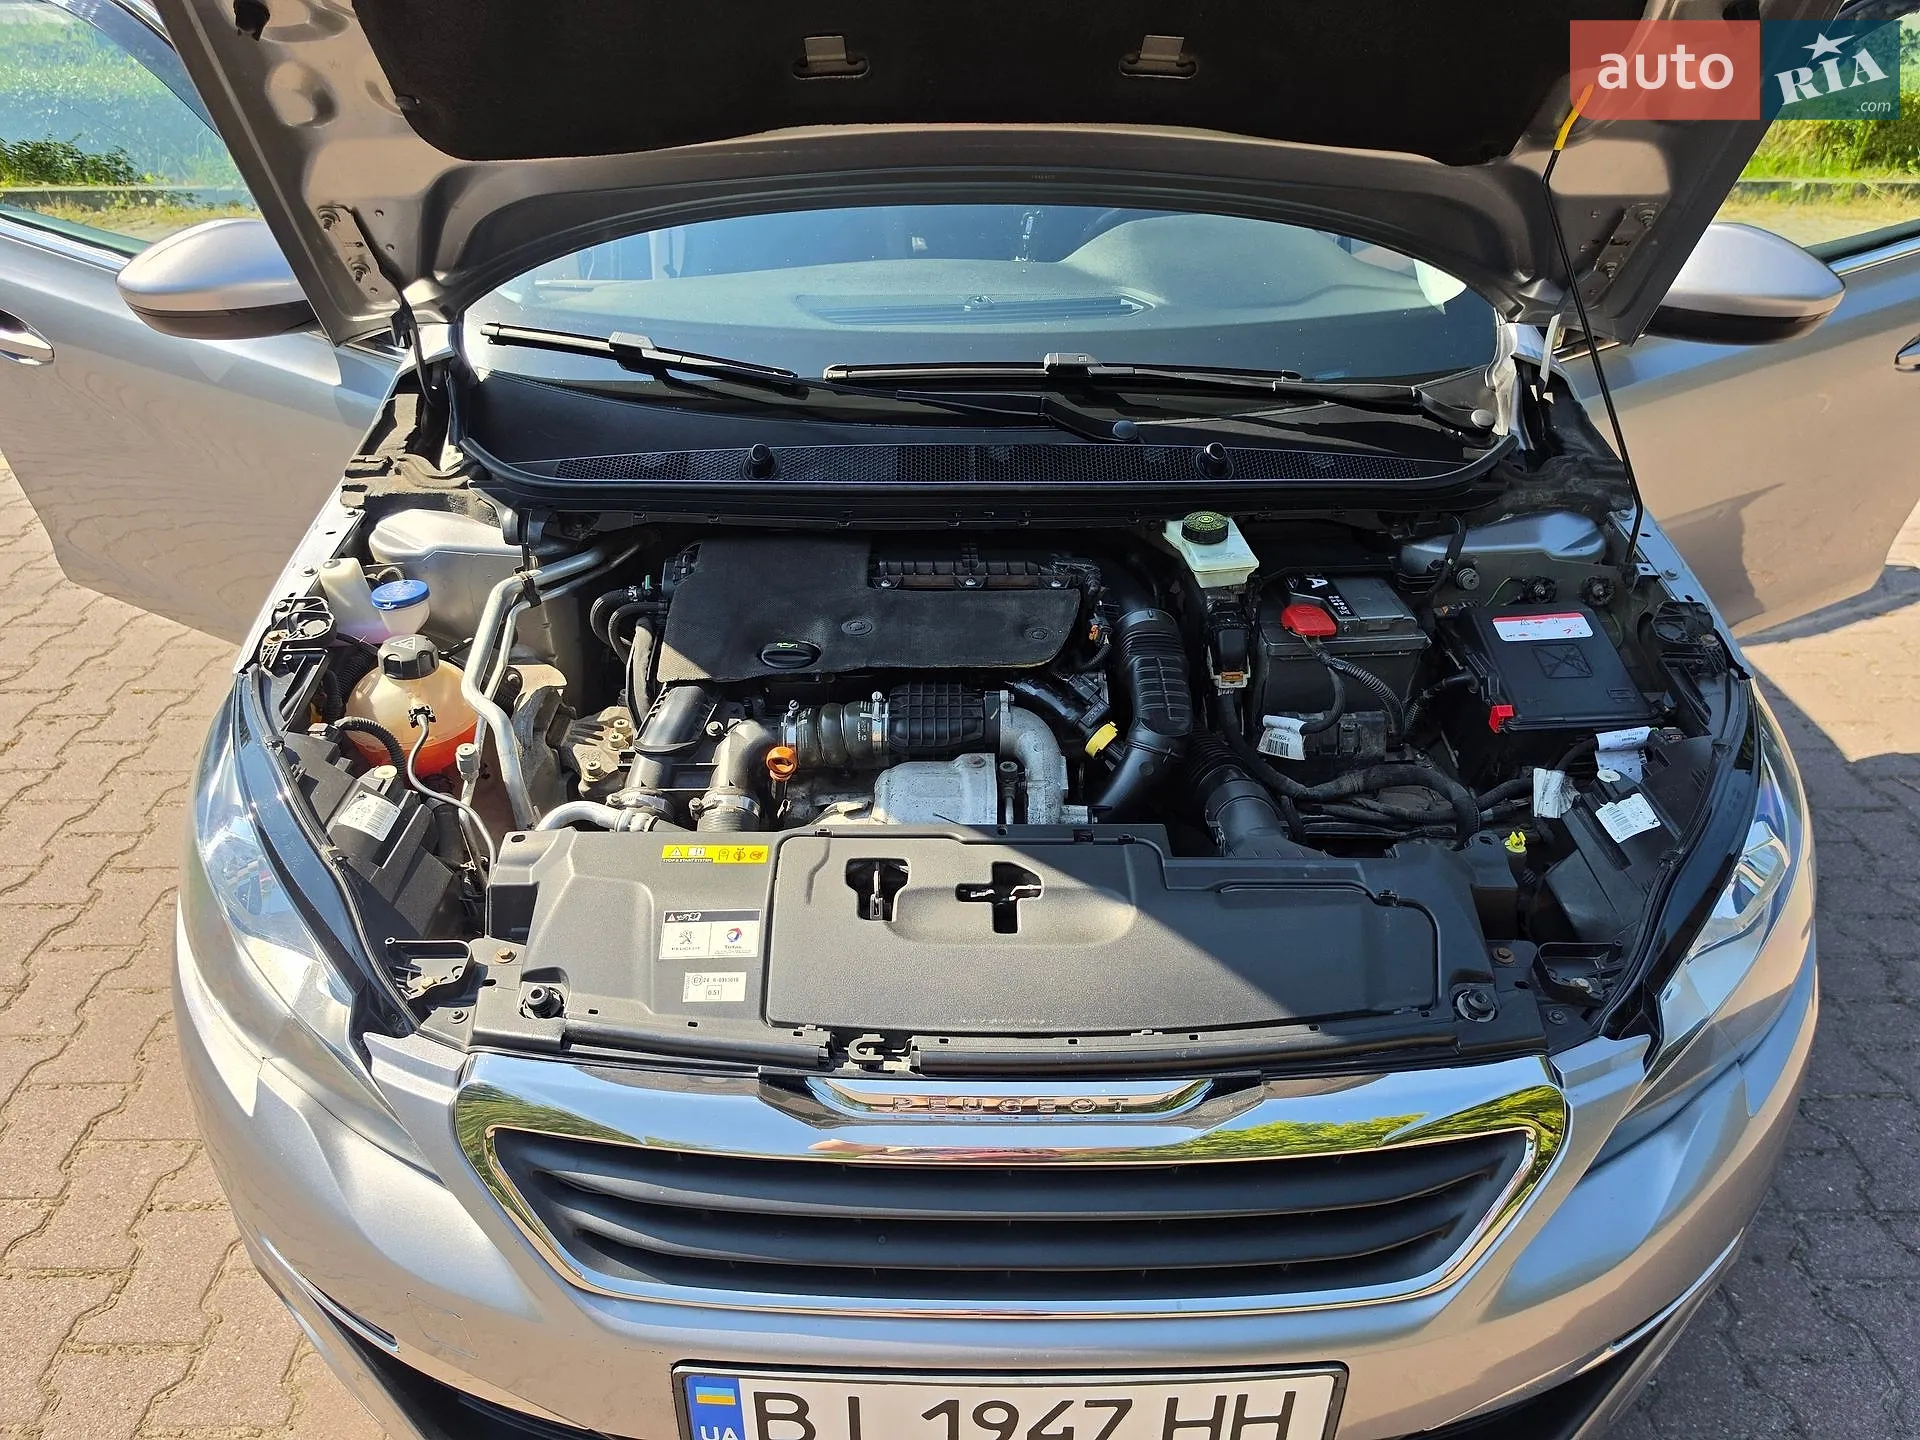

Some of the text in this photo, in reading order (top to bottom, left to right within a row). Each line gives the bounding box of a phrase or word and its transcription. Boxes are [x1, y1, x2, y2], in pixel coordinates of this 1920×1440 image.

[892, 1096, 1129, 1114] PEUGEOT
[921, 1398, 1133, 1440] 1947
[1162, 1390, 1297, 1440] HH
